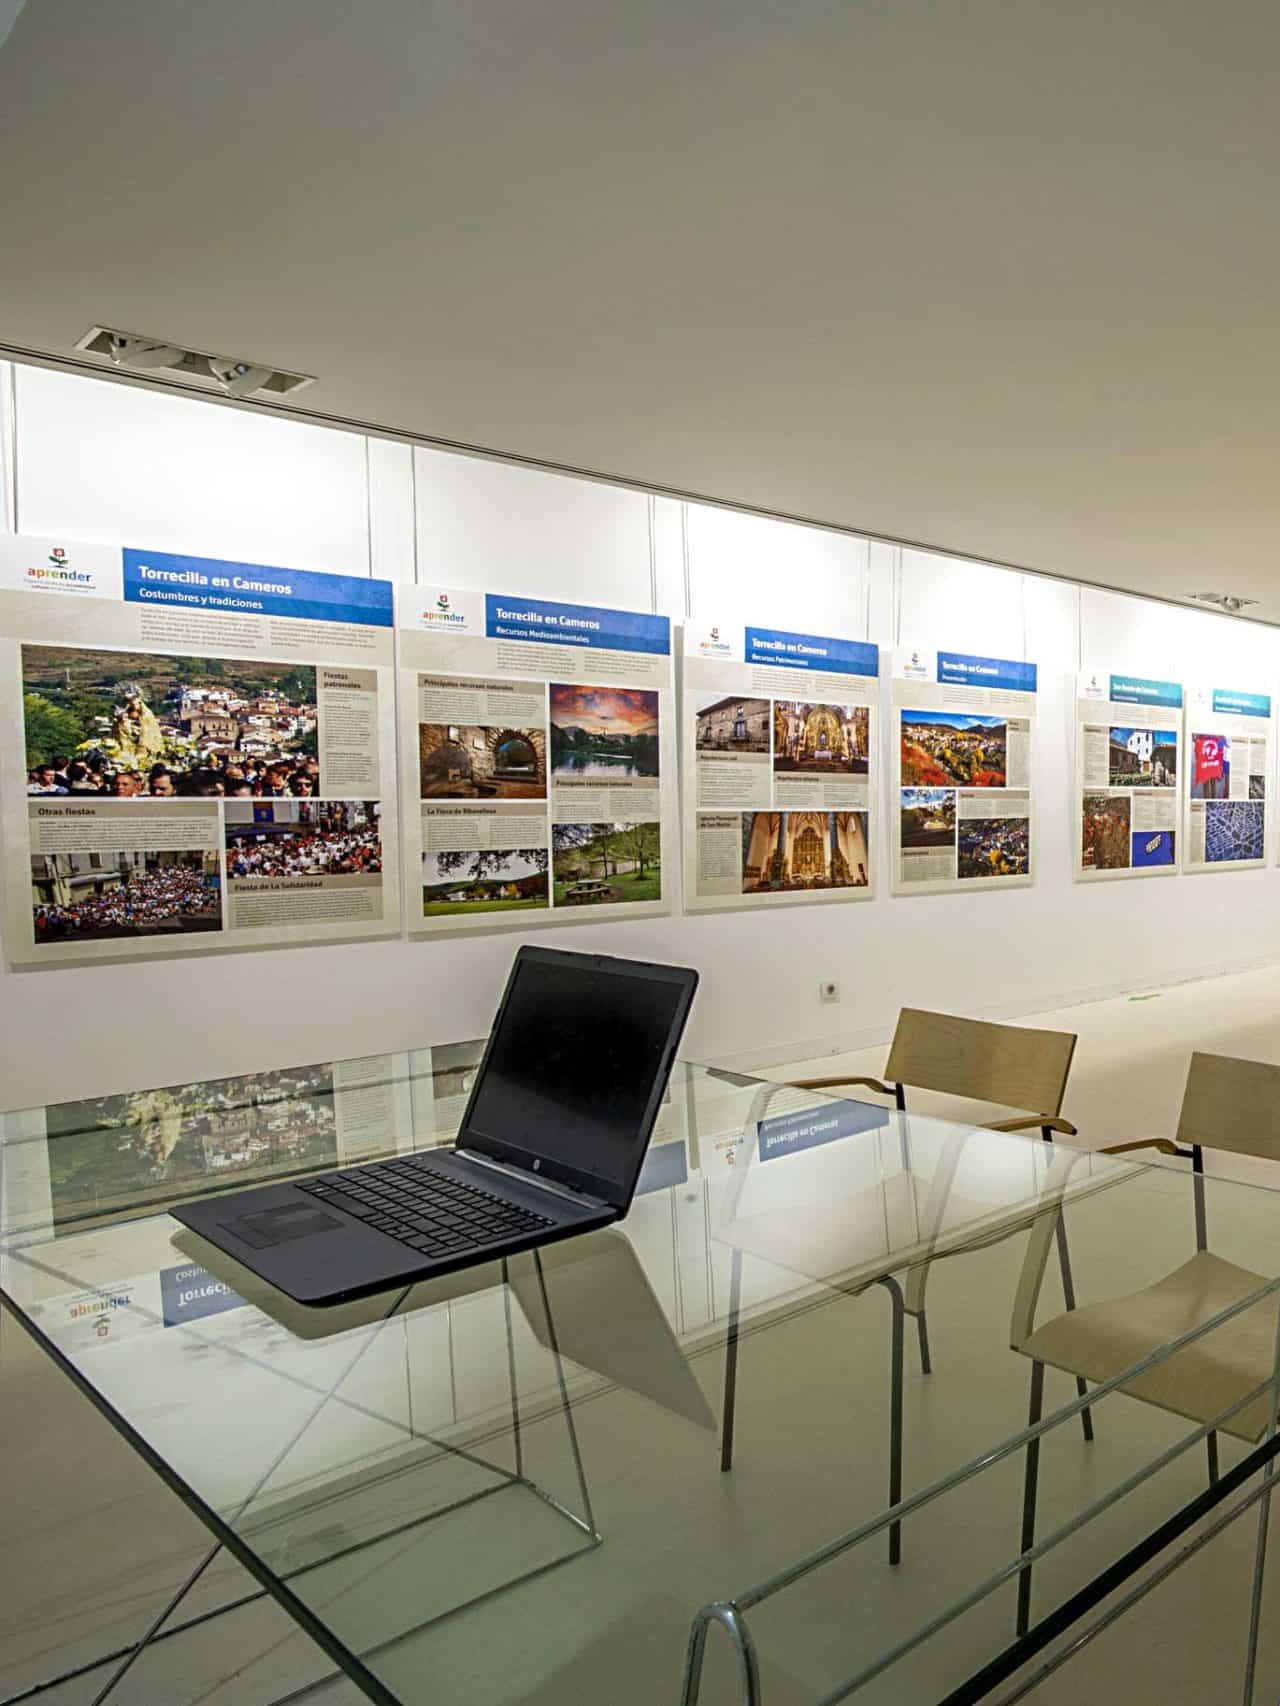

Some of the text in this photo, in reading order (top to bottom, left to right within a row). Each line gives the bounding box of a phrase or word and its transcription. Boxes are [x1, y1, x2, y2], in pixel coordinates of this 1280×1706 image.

[27, 568, 92, 582] aprender
[138, 566, 292, 595] Torrecilla en Cameros
[139, 588, 263, 610] Costumbres y tradiciones
[422, 611, 465, 623] aprender
[495, 607, 601, 630] Torrecilla en Cameros
[496, 626, 528, 637] Recursos
[323, 671, 348, 680] Fiestas
[38, 808, 96, 816] Otras fiestas
[234, 883, 258, 892] Fiesta
[260, 882, 269, 890] de
[271, 882, 280, 890] La
